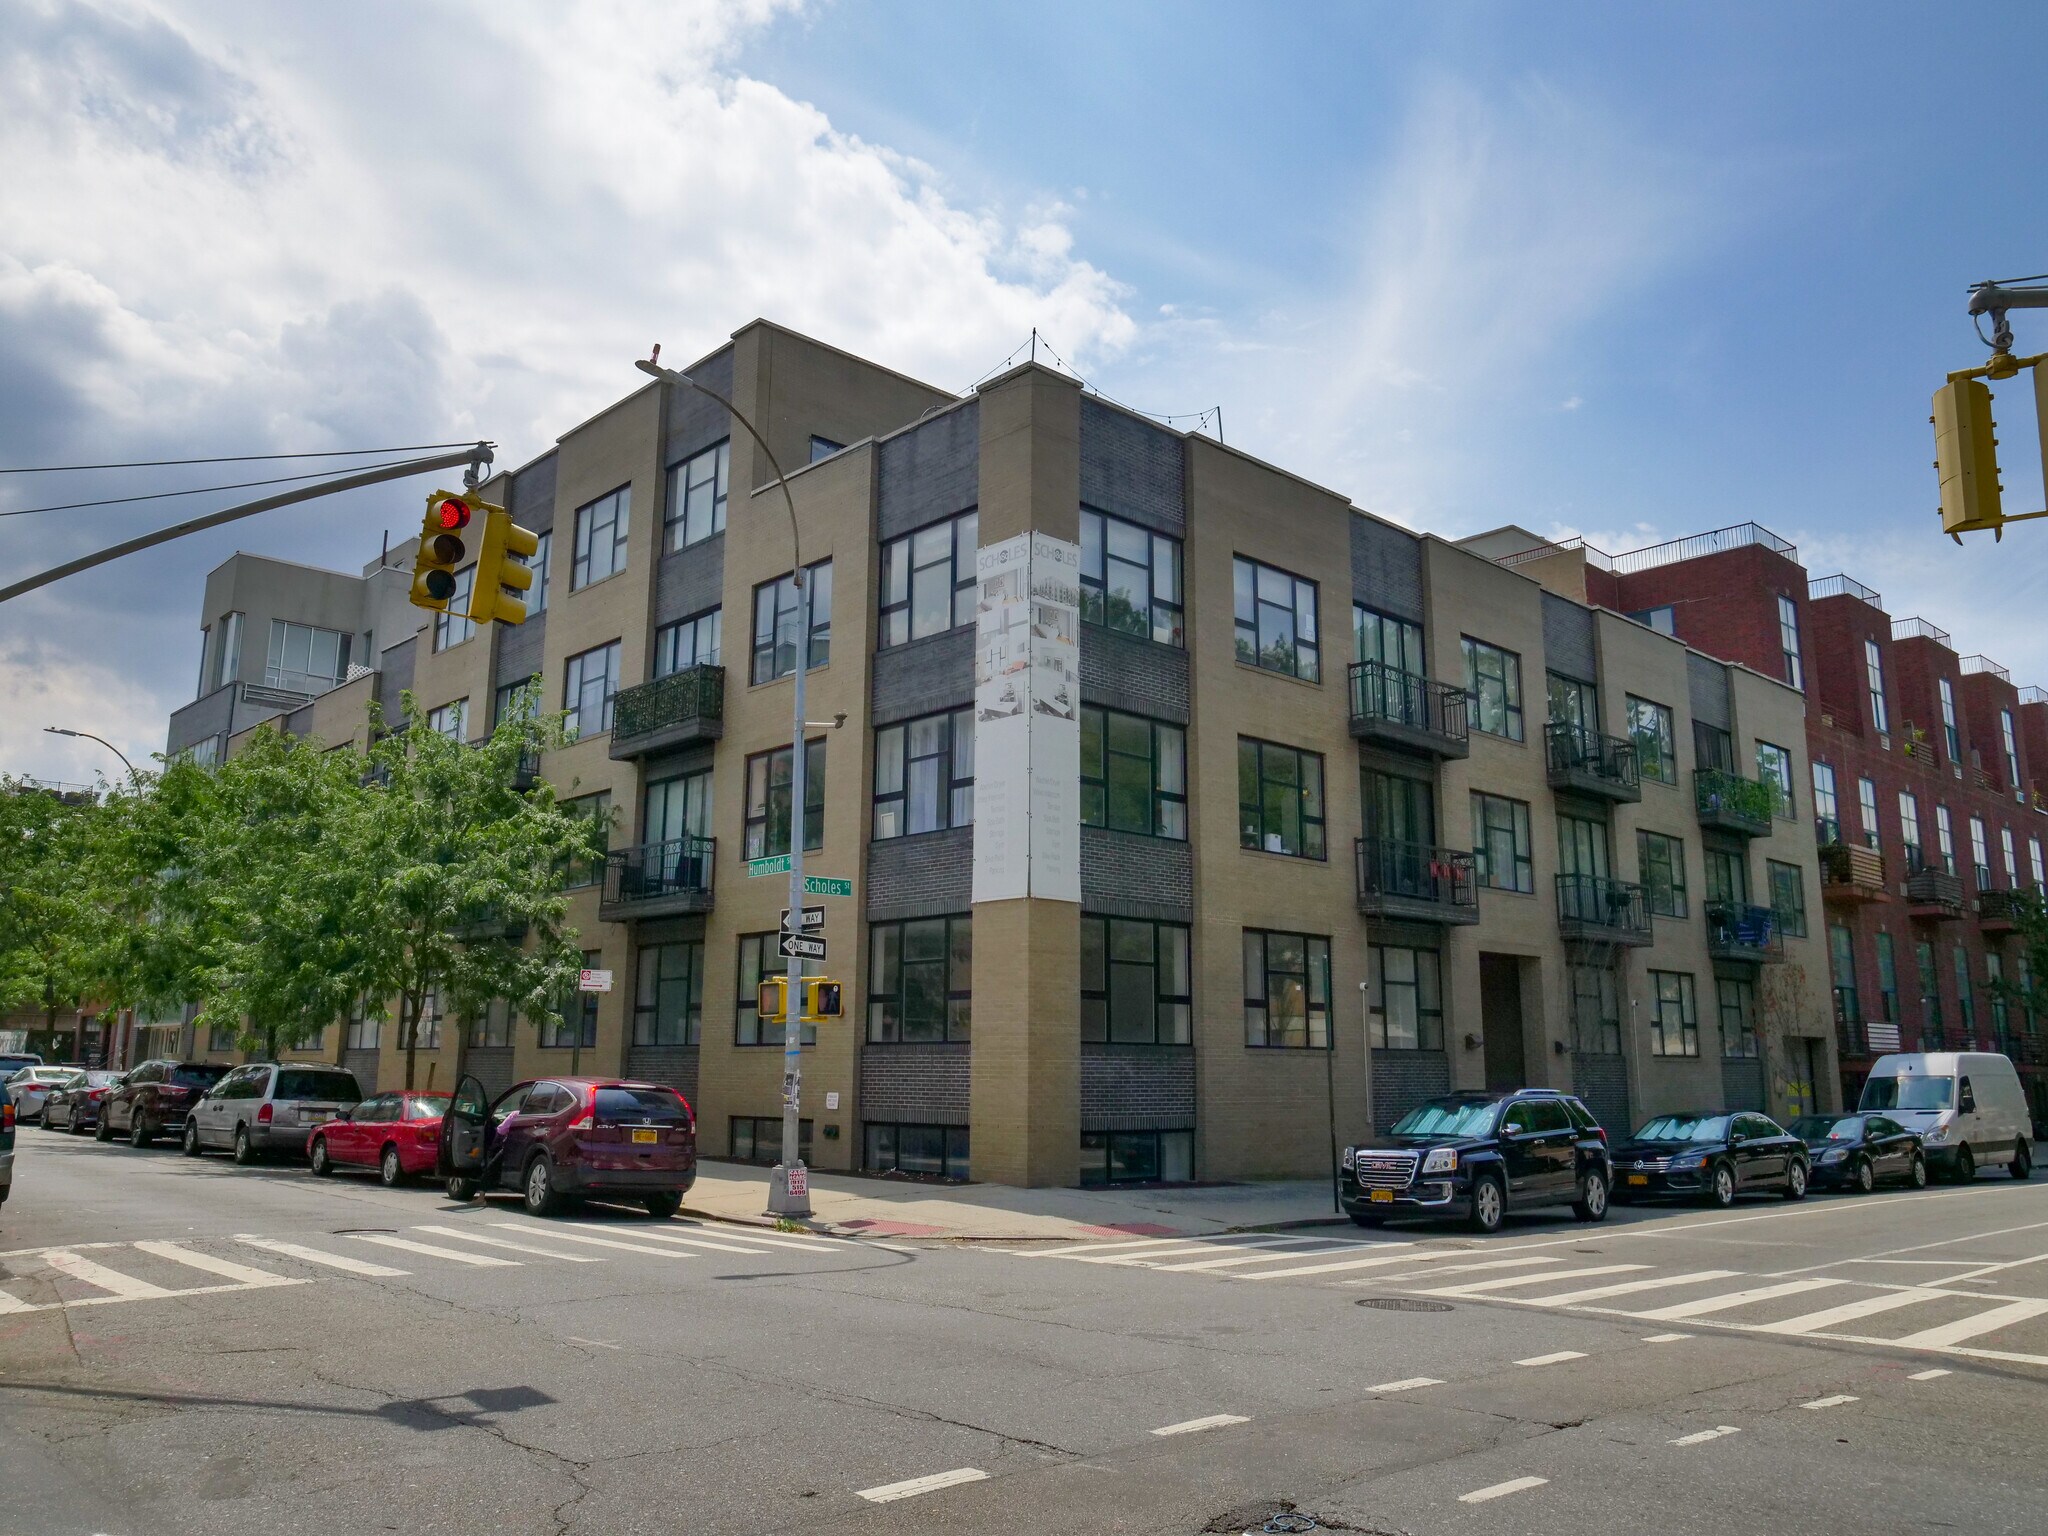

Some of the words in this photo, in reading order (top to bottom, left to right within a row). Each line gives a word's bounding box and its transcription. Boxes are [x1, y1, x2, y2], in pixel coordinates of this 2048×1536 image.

[749, 859, 784, 875] Humboldt
[804, 878, 842, 895] Scholes
[844, 882, 851, 890] St
[805, 913, 820, 924] WAY
[788, 940, 804, 951] ONE
[808, 943, 822, 953] WAY
[1371, 1161, 1398, 1170] GMC
